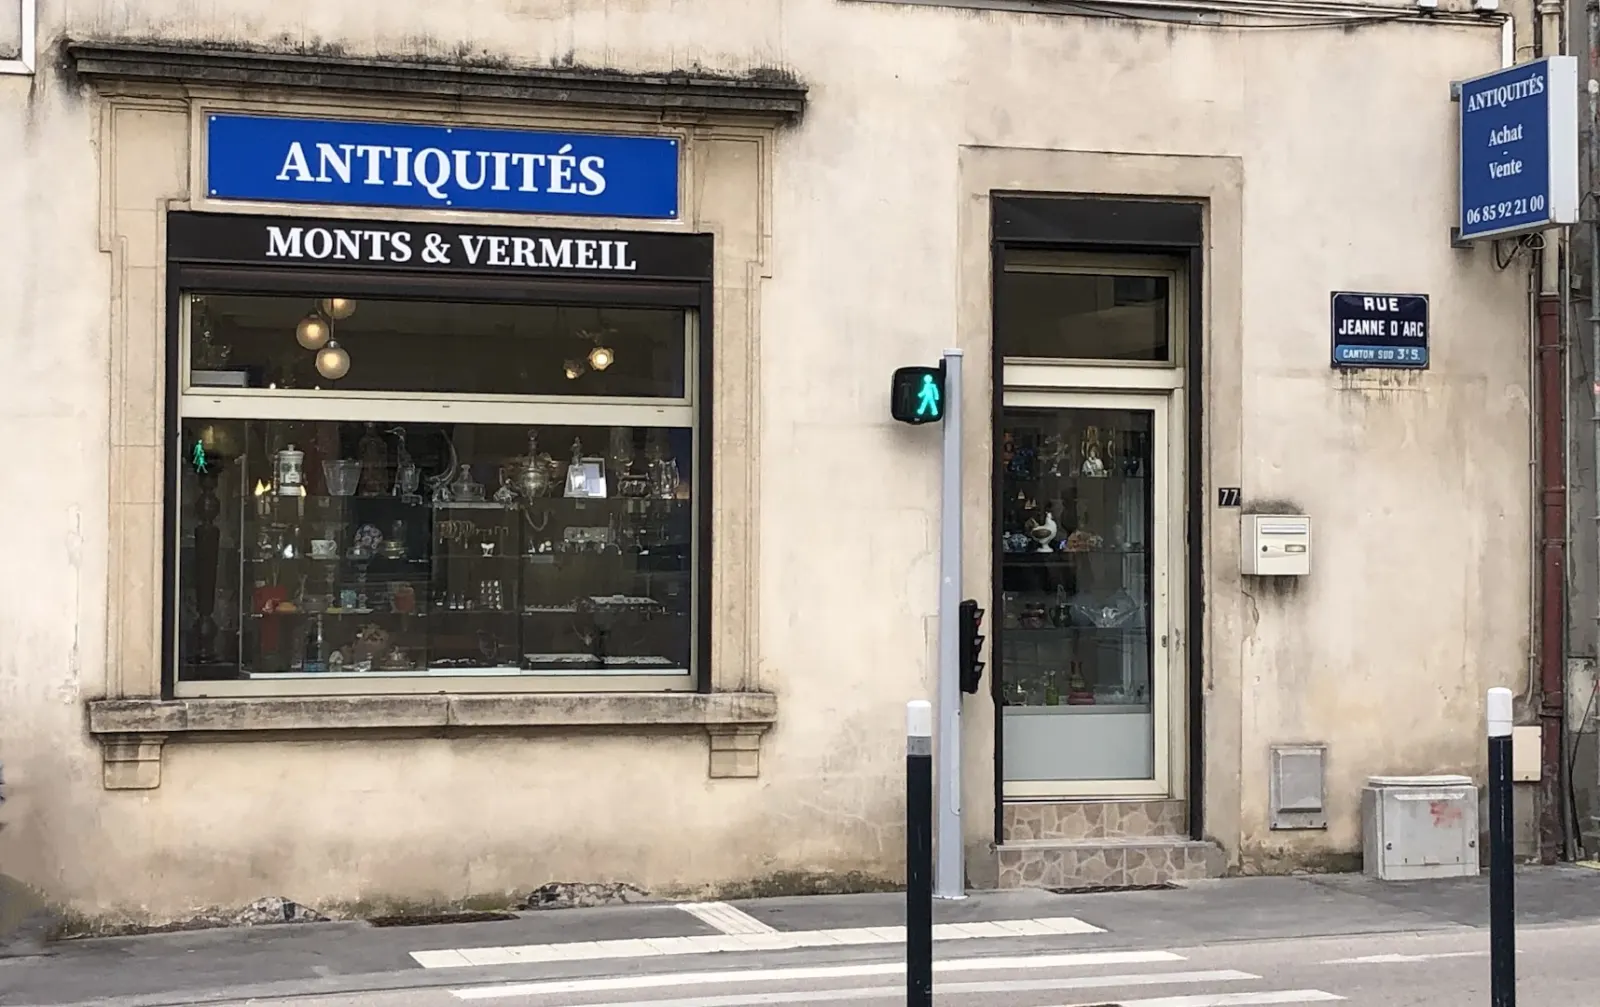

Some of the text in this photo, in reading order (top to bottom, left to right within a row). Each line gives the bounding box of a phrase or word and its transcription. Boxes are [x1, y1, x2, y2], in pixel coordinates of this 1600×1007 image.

[1467, 73, 1544, 112] ANTIQUITÉS
[1488, 123, 1523, 147] Achat
[275, 142, 606, 199] ANTIQUITÉS
[1489, 159, 1523, 179] Vente
[1467, 194, 1544, 225] 06 85 92 21 00
[266, 226, 636, 270] MONTS & VERMEIL
[1363, 297, 1399, 311] RUE
[1338, 319, 1424, 337] JEANNE D'ARC
[1343, 349, 1375, 359] CANTON
[1378, 350, 1394, 359] SUD
[1220, 489, 1238, 505] 77
